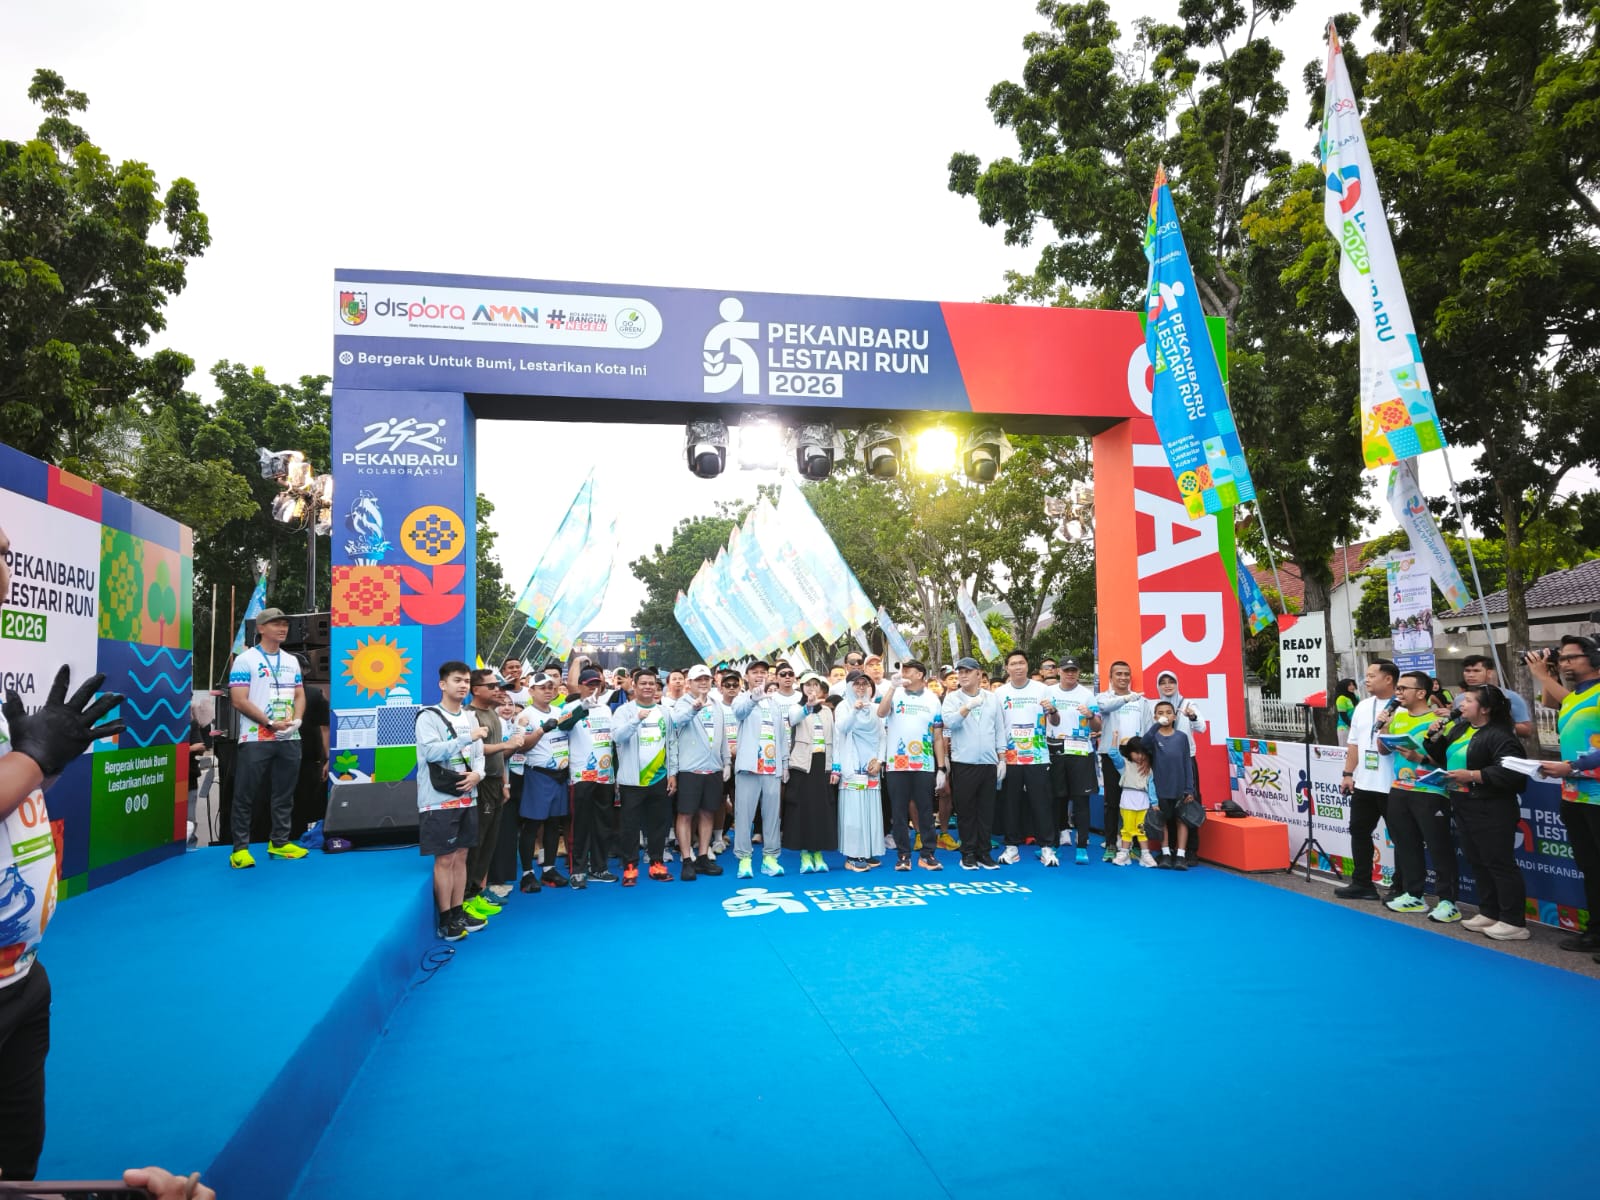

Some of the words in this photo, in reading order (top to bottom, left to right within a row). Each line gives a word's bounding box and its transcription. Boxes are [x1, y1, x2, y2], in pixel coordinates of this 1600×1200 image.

[374, 296, 465, 321] dispora
[472, 304, 539, 323] AMAN
[566, 322, 607, 331] NEGERI
[568, 316, 606, 324] BANGUN
[768, 322, 929, 350] PEKANBARU
[358, 352, 425, 366] Bergerak
[429, 355, 472, 367] Untuk
[476, 357, 516, 371] Bumi,
[520, 359, 592, 374] Lestarikan
[595, 362, 627, 375] Kota
[630, 364, 647, 376] Ini
[768, 348, 868, 372] LESTARI
[875, 352, 929, 374] RUN
[1169, 313, 1206, 418] PEKANBARU
[1158, 320, 1187, 382] LESTARI
[1178, 383, 1198, 421] RUN
[775, 374, 836, 395] 2026
[342, 453, 458, 466] PEKANBARU
[358, 466, 443, 476] KOLABORAKSI
[65, 591, 94, 617] RUN
[5, 612, 43, 640] 2026
[1282, 637, 1322, 650] READY
[1296, 653, 1309, 663] TO
[1286, 666, 1321, 679] START
[104, 758, 134, 776] Bergerak
[135, 756, 152, 769] Untuk
[153, 754, 168, 767] Bumi
[108, 776, 142, 792] Lestarikan
[142, 773, 156, 786] Kota
[1246, 788, 1288, 802] PEKANBARU
[1319, 806, 1342, 818] 2026
[803, 880, 1019, 897] PEKANBARU
[809, 889, 949, 903] LESTARI
[955, 886, 1033, 896] RUN
[830, 897, 916, 910] 2026
